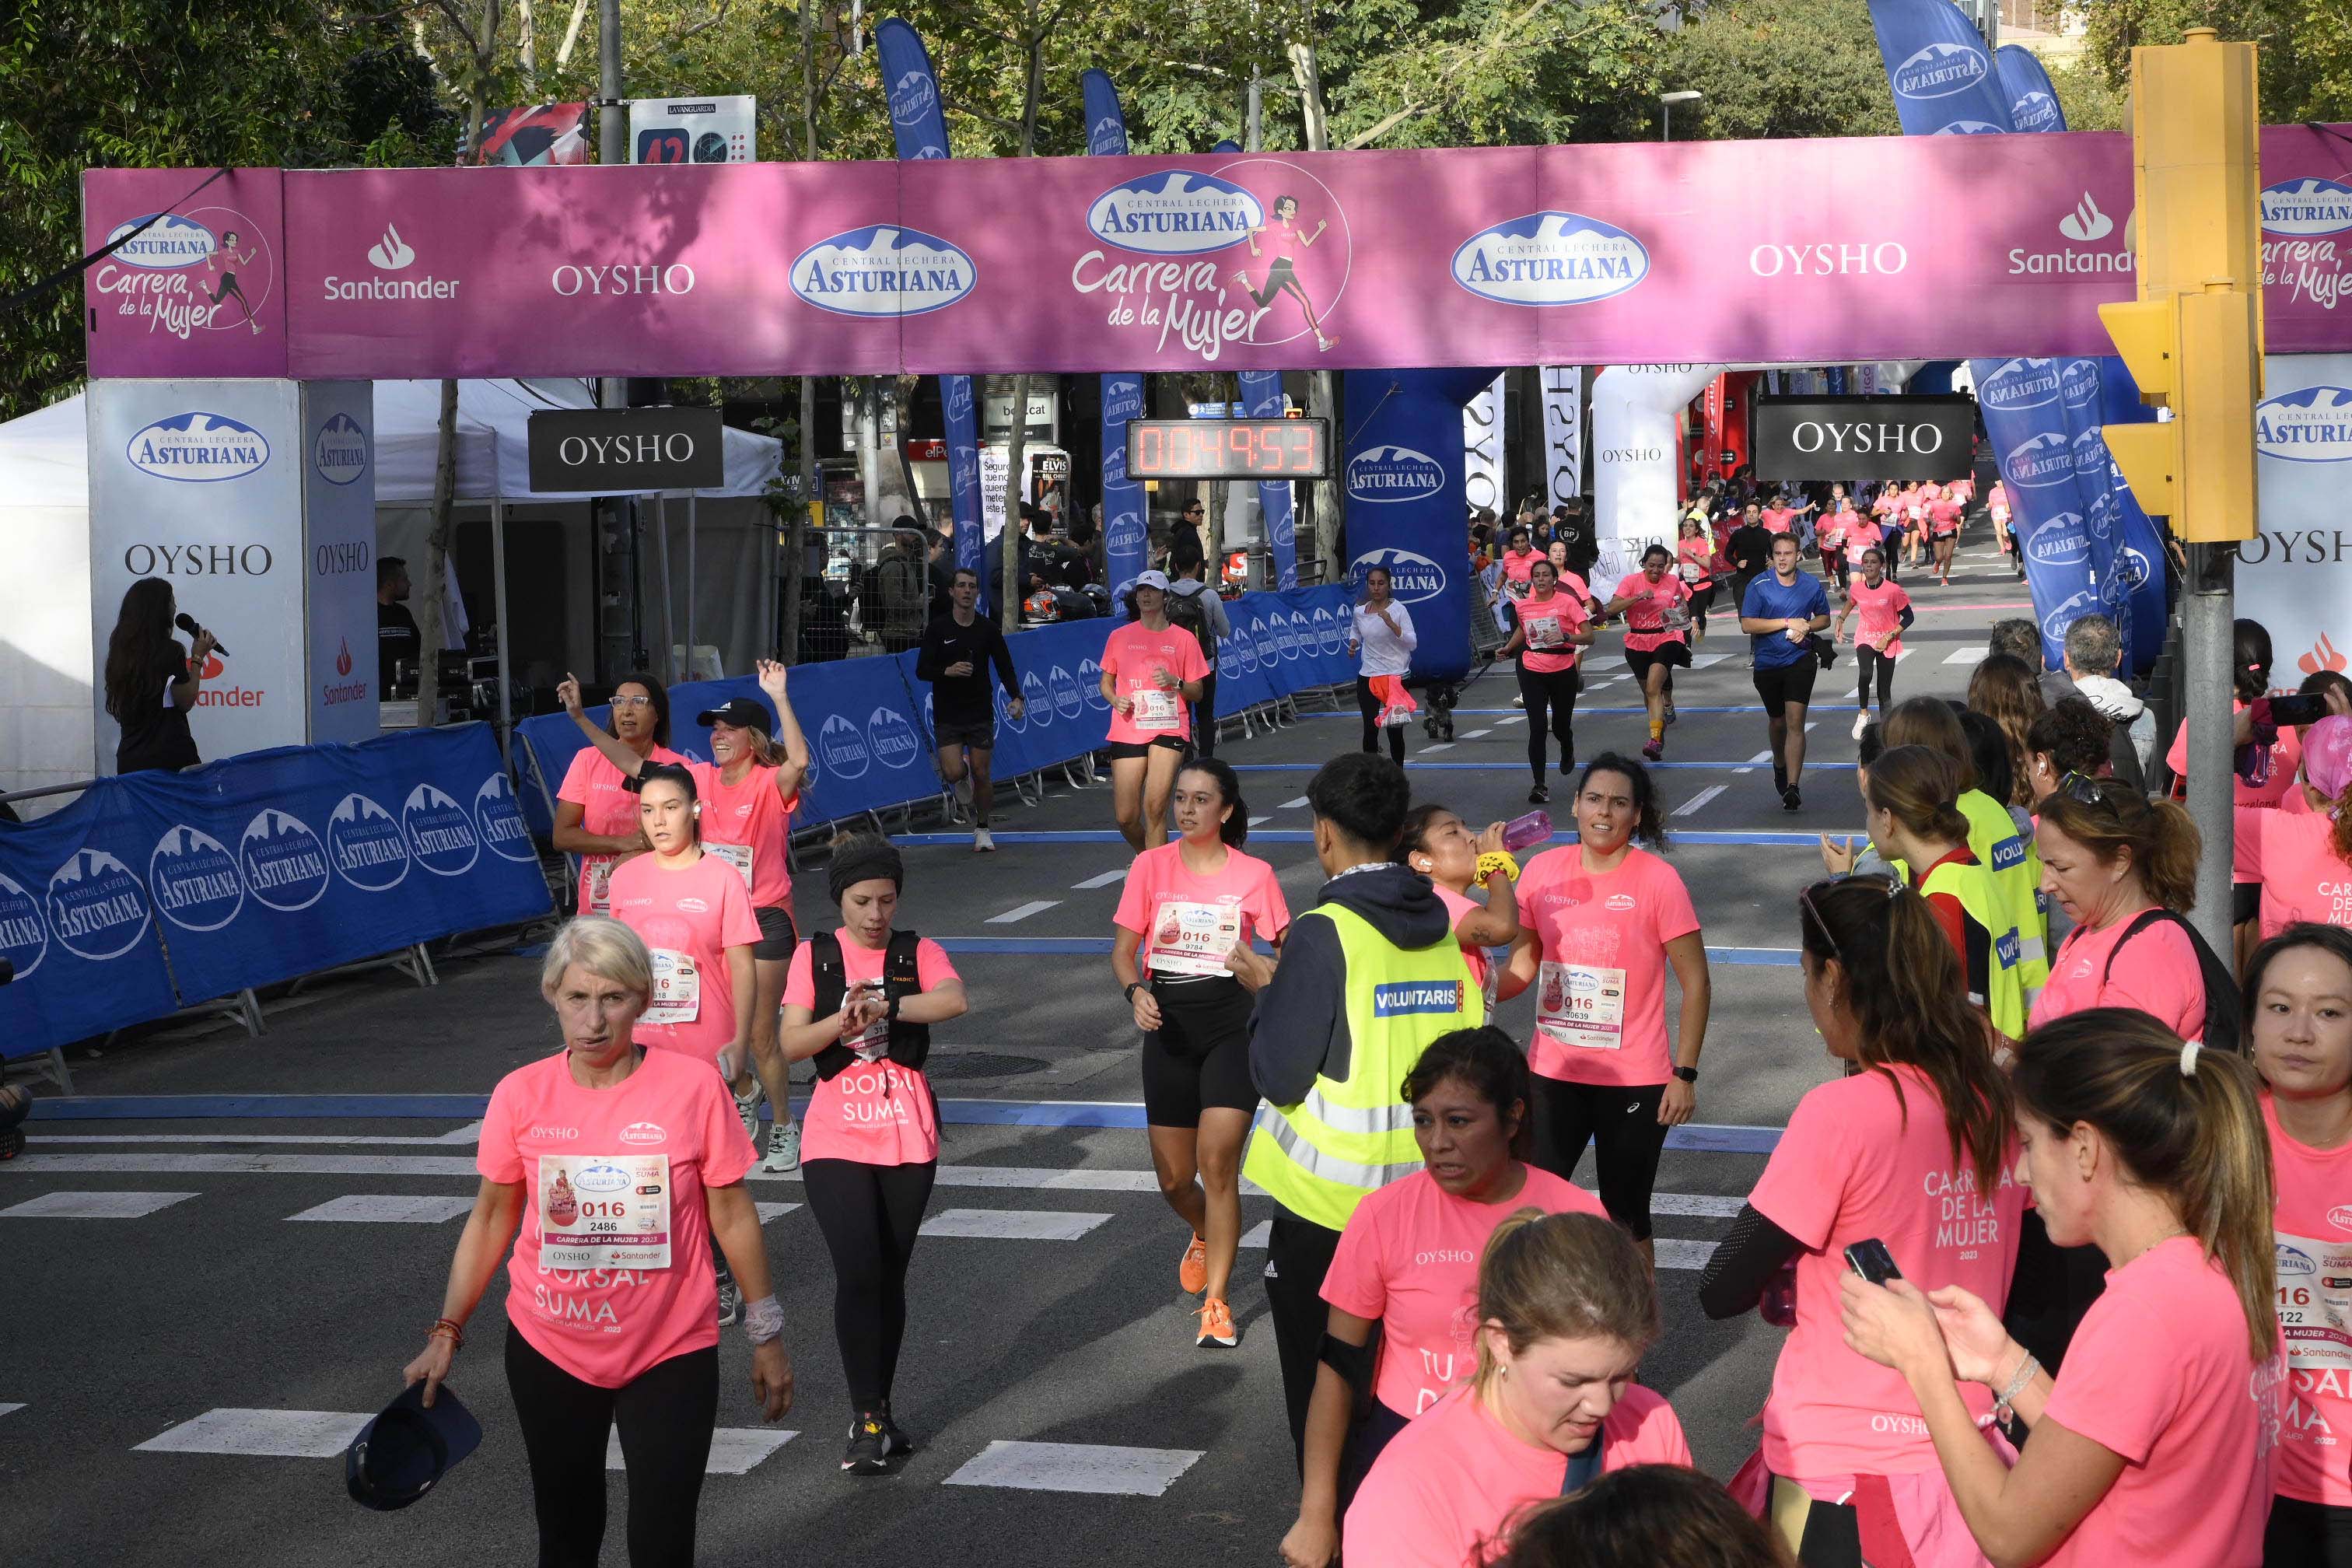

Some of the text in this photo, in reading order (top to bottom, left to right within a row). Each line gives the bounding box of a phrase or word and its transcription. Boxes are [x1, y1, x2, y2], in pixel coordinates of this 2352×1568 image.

[1127, 198, 1246, 208] CENTRAL LECHERA
[2260, 200, 2352, 221] ASTURIAN
[1100, 201, 1249, 233] ASTURIANA
[115, 233, 207, 254] ASTURIANA
[1496, 242, 1628, 254] CENTRAL LECHERA
[831, 255, 956, 266] CENTRAL LECHERA
[1466, 247, 1633, 283] ASTURIANA
[1750, 242, 1907, 277] OYSHO
[96, 264, 187, 294] Carrera
[552, 264, 695, 296] OYSHO
[804, 258, 962, 293] ASTURIANA
[1072, 250, 1219, 294] Carrera
[2280, 263, 2294, 285] la
[324, 275, 459, 300] Santander
[119, 291, 222, 339] de la Mujer
[1108, 287, 1271, 361] de la Mujer
[1792, 421, 1942, 454] OYSHO
[138, 439, 260, 464] ASTURIANA
[320, 441, 365, 467] ASTURIANA
[560, 433, 694, 465] OYSHO
[1139, 428, 1314, 471] 00:49:53
[1602, 448, 1661, 464] OYSHO
[1043, 460, 1066, 471] ELVIS
[1349, 468, 1437, 489] ASTURIANA
[125, 544, 272, 576] OYSHO
[317, 541, 369, 576] OYSHO
[324, 681, 366, 706] Santander
[1129, 679, 1142, 688] TU
[194, 686, 264, 707] ander
[824, 741, 867, 765] ASTURIANA
[593, 782, 618, 792] OYSHO
[410, 821, 476, 857] ASTURIANA
[335, 834, 407, 871] ASTURIANA
[247, 852, 326, 891] ASTURIANA
[159, 869, 240, 910] ASTURIANA
[1156, 891, 1188, 901] OYSHO
[1545, 894, 1579, 907] OYSHO
[1183, 932, 1210, 942] 016
[1566, 978, 1596, 988] ASTURIANA
[1376, 989, 1456, 1009] VOLUNTARIS
[1565, 996, 1593, 1010] 016
[1566, 1011, 1589, 1020] 30639
[843, 1097, 905, 1122] SUMA
[530, 1126, 579, 1139] OYSHO
[623, 1131, 663, 1140] ASTURIANA
[1923, 1165, 2012, 1196] CARRA
[582, 1202, 625, 1217] 016
[1942, 1194, 1995, 1221] DE LA
[590, 1222, 617, 1232] 2486
[1935, 1220, 1998, 1249] MUJER
[556, 1235, 589, 1244] CARRERA
[553, 1251, 590, 1262] OYSHO
[1416, 1251, 1474, 1265] OYSHO
[1959, 1250, 1978, 1260] 2023
[535, 1283, 618, 1323] SUMA
[2277, 1287, 2310, 1305] 16
[2278, 1311, 2303, 1322] 122
[2328, 1332, 2347, 1342] 2023
[2303, 1347, 2352, 1360] Santander
[1419, 1348, 1453, 1381] TU
[2315, 1437, 2337, 1445] 2023
